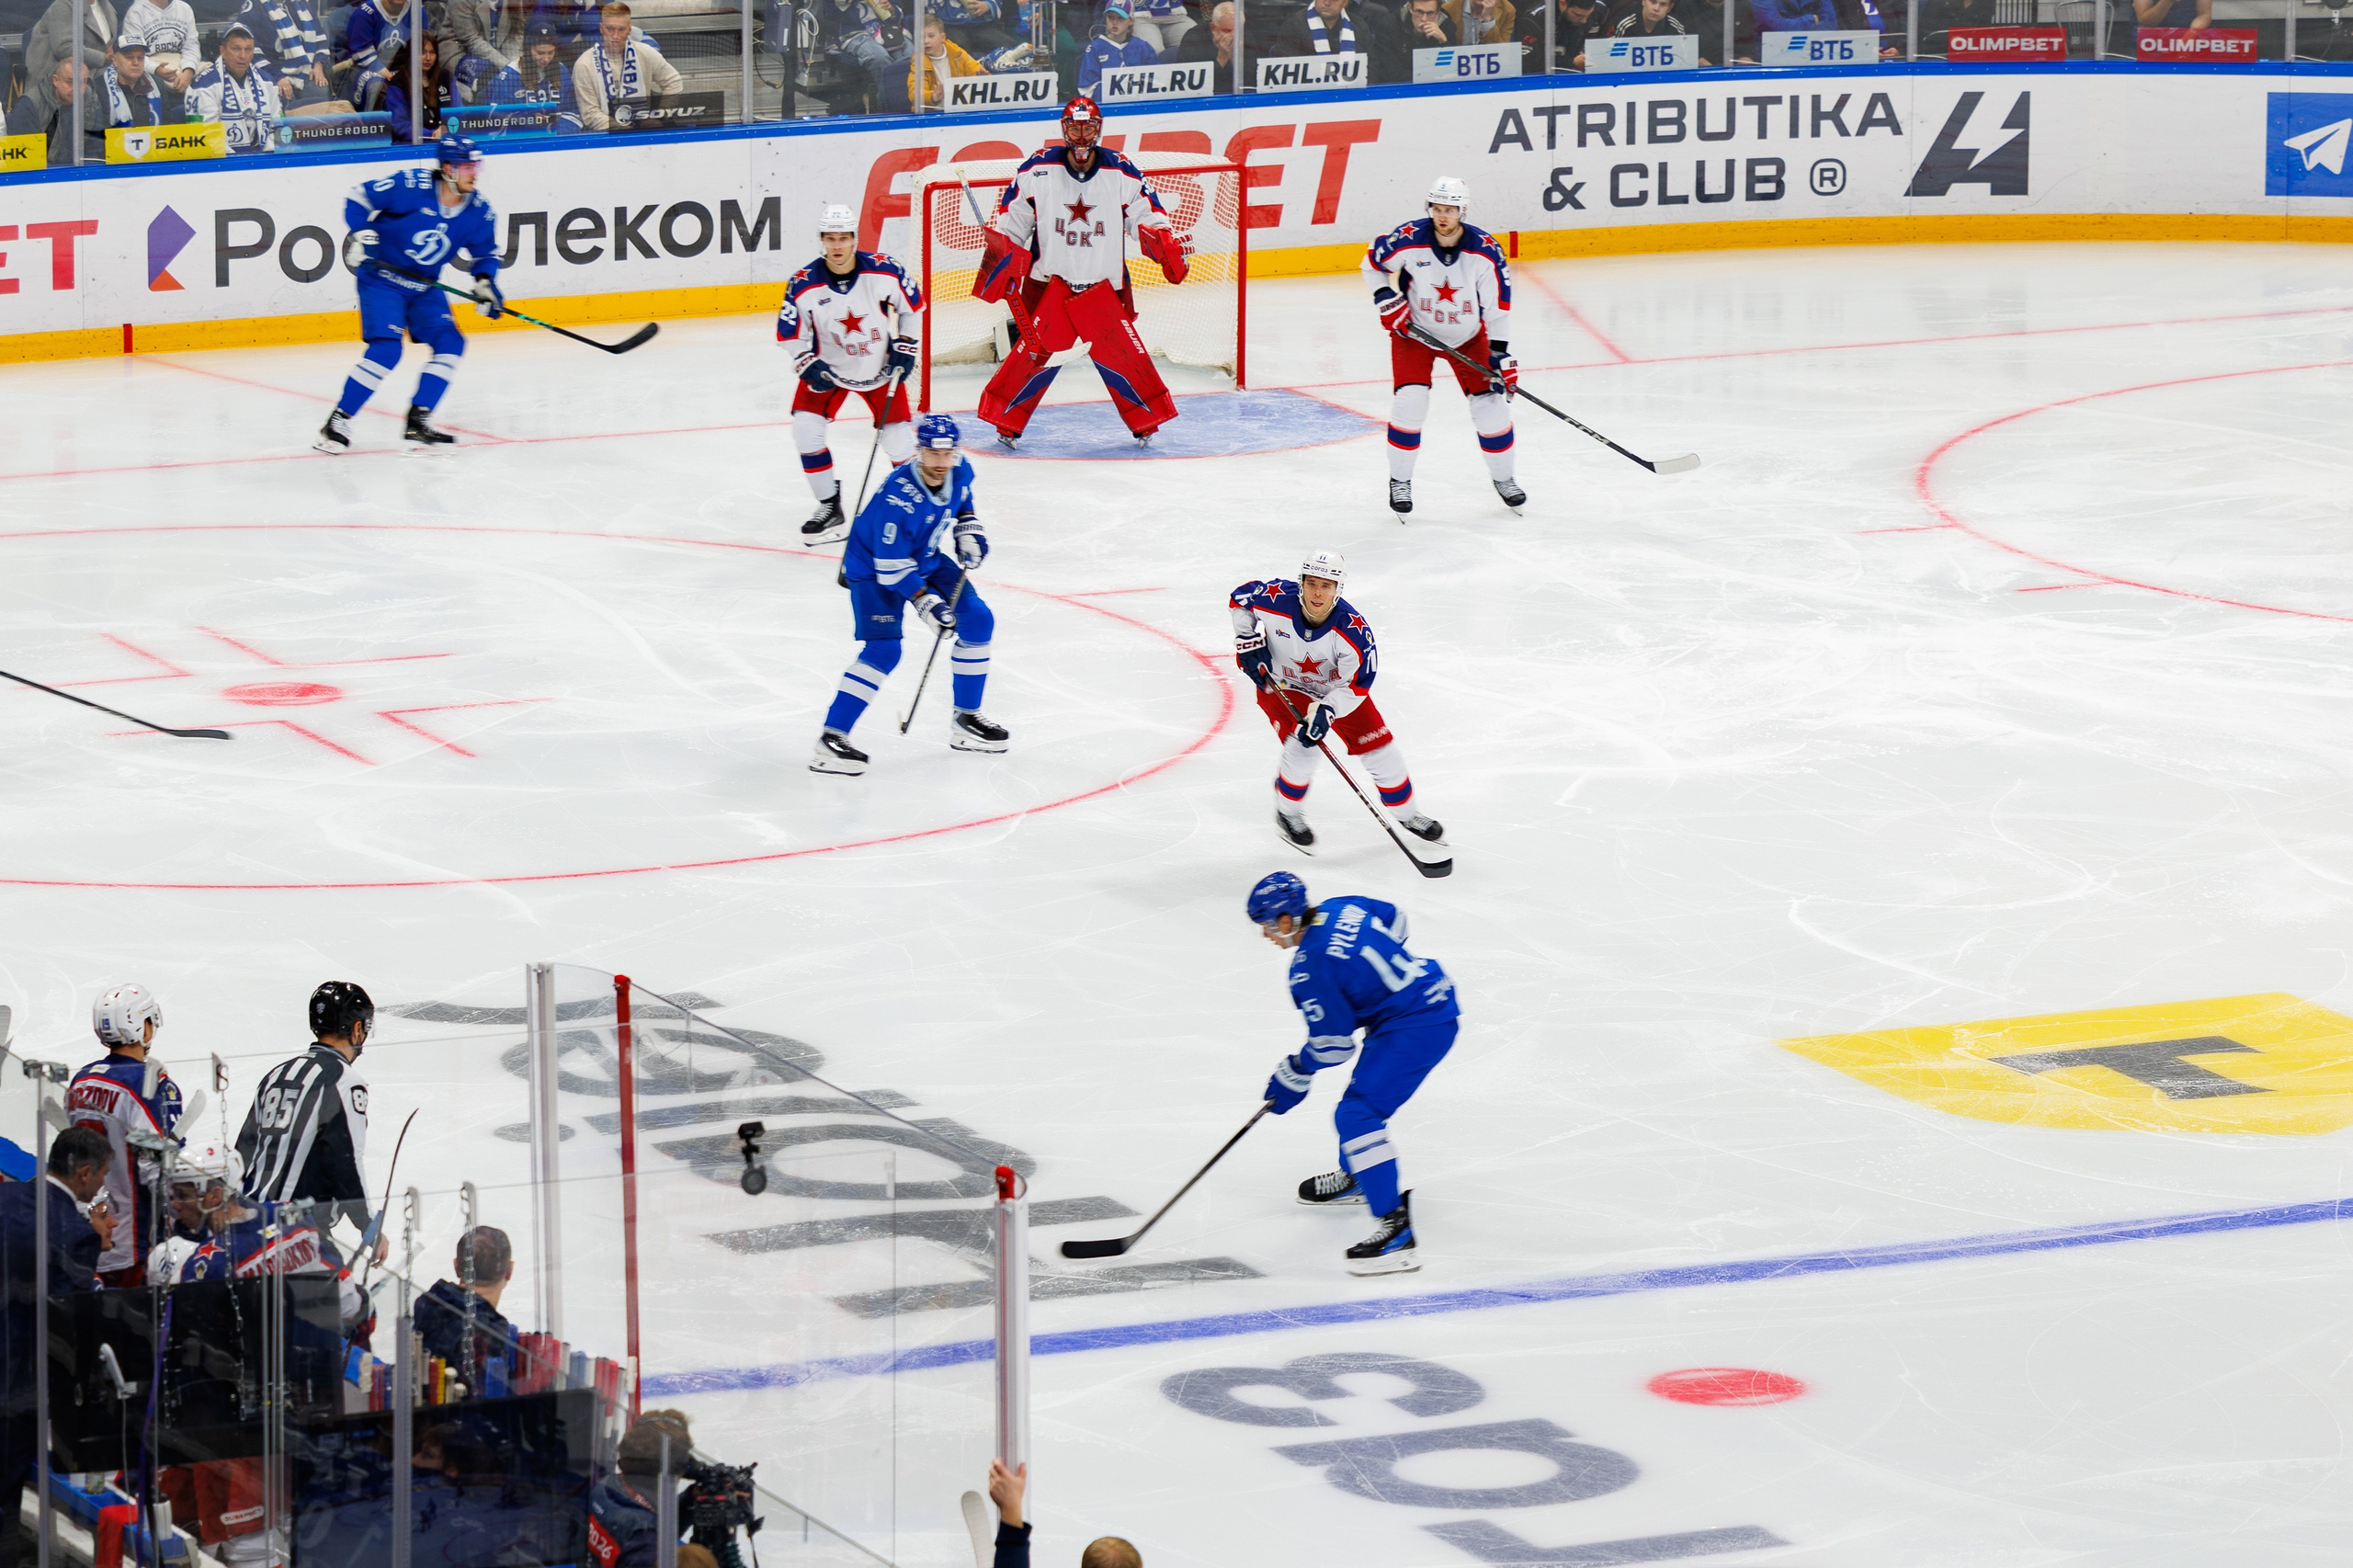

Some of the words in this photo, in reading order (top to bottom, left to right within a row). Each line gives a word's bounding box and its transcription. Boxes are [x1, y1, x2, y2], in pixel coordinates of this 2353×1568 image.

[1810, 40, 1854, 61] ВТБ
[1950, 37, 2063, 51] OLIMPBET
[2140, 38, 2254, 53] OLIMPBET
[1457, 52, 1501, 76] ВТБ
[1631, 45, 1674, 67] ВТБ
[1109, 69, 1207, 97] KHL.RU
[1264, 61, 1360, 85] KHL.RU
[951, 79, 1051, 105] KHL.RU
[185, 96, 199, 113] 54
[635, 107, 706, 119] SOYUZ
[295, 125, 386, 139] THUNDEROBOT
[461, 116, 551, 129] THUNDEROBOT
[1488, 93, 1904, 153] ATRIBUTIKA
[155, 135, 206, 150] БАНК
[1542, 167, 1586, 211] &
[1609, 157, 1786, 209] CLUB
[215, 196, 781, 288] Ролеком
[1054, 217, 1107, 247] ЦСКА
[1419, 298, 1473, 324] ЦСКА
[1120, 319, 1144, 354] BAUER
[882, 522, 898, 544] 9
[1290, 684, 1326, 700] РОСН
[102, 1018, 111, 1030] 19
[261, 1087, 299, 1130] 85
